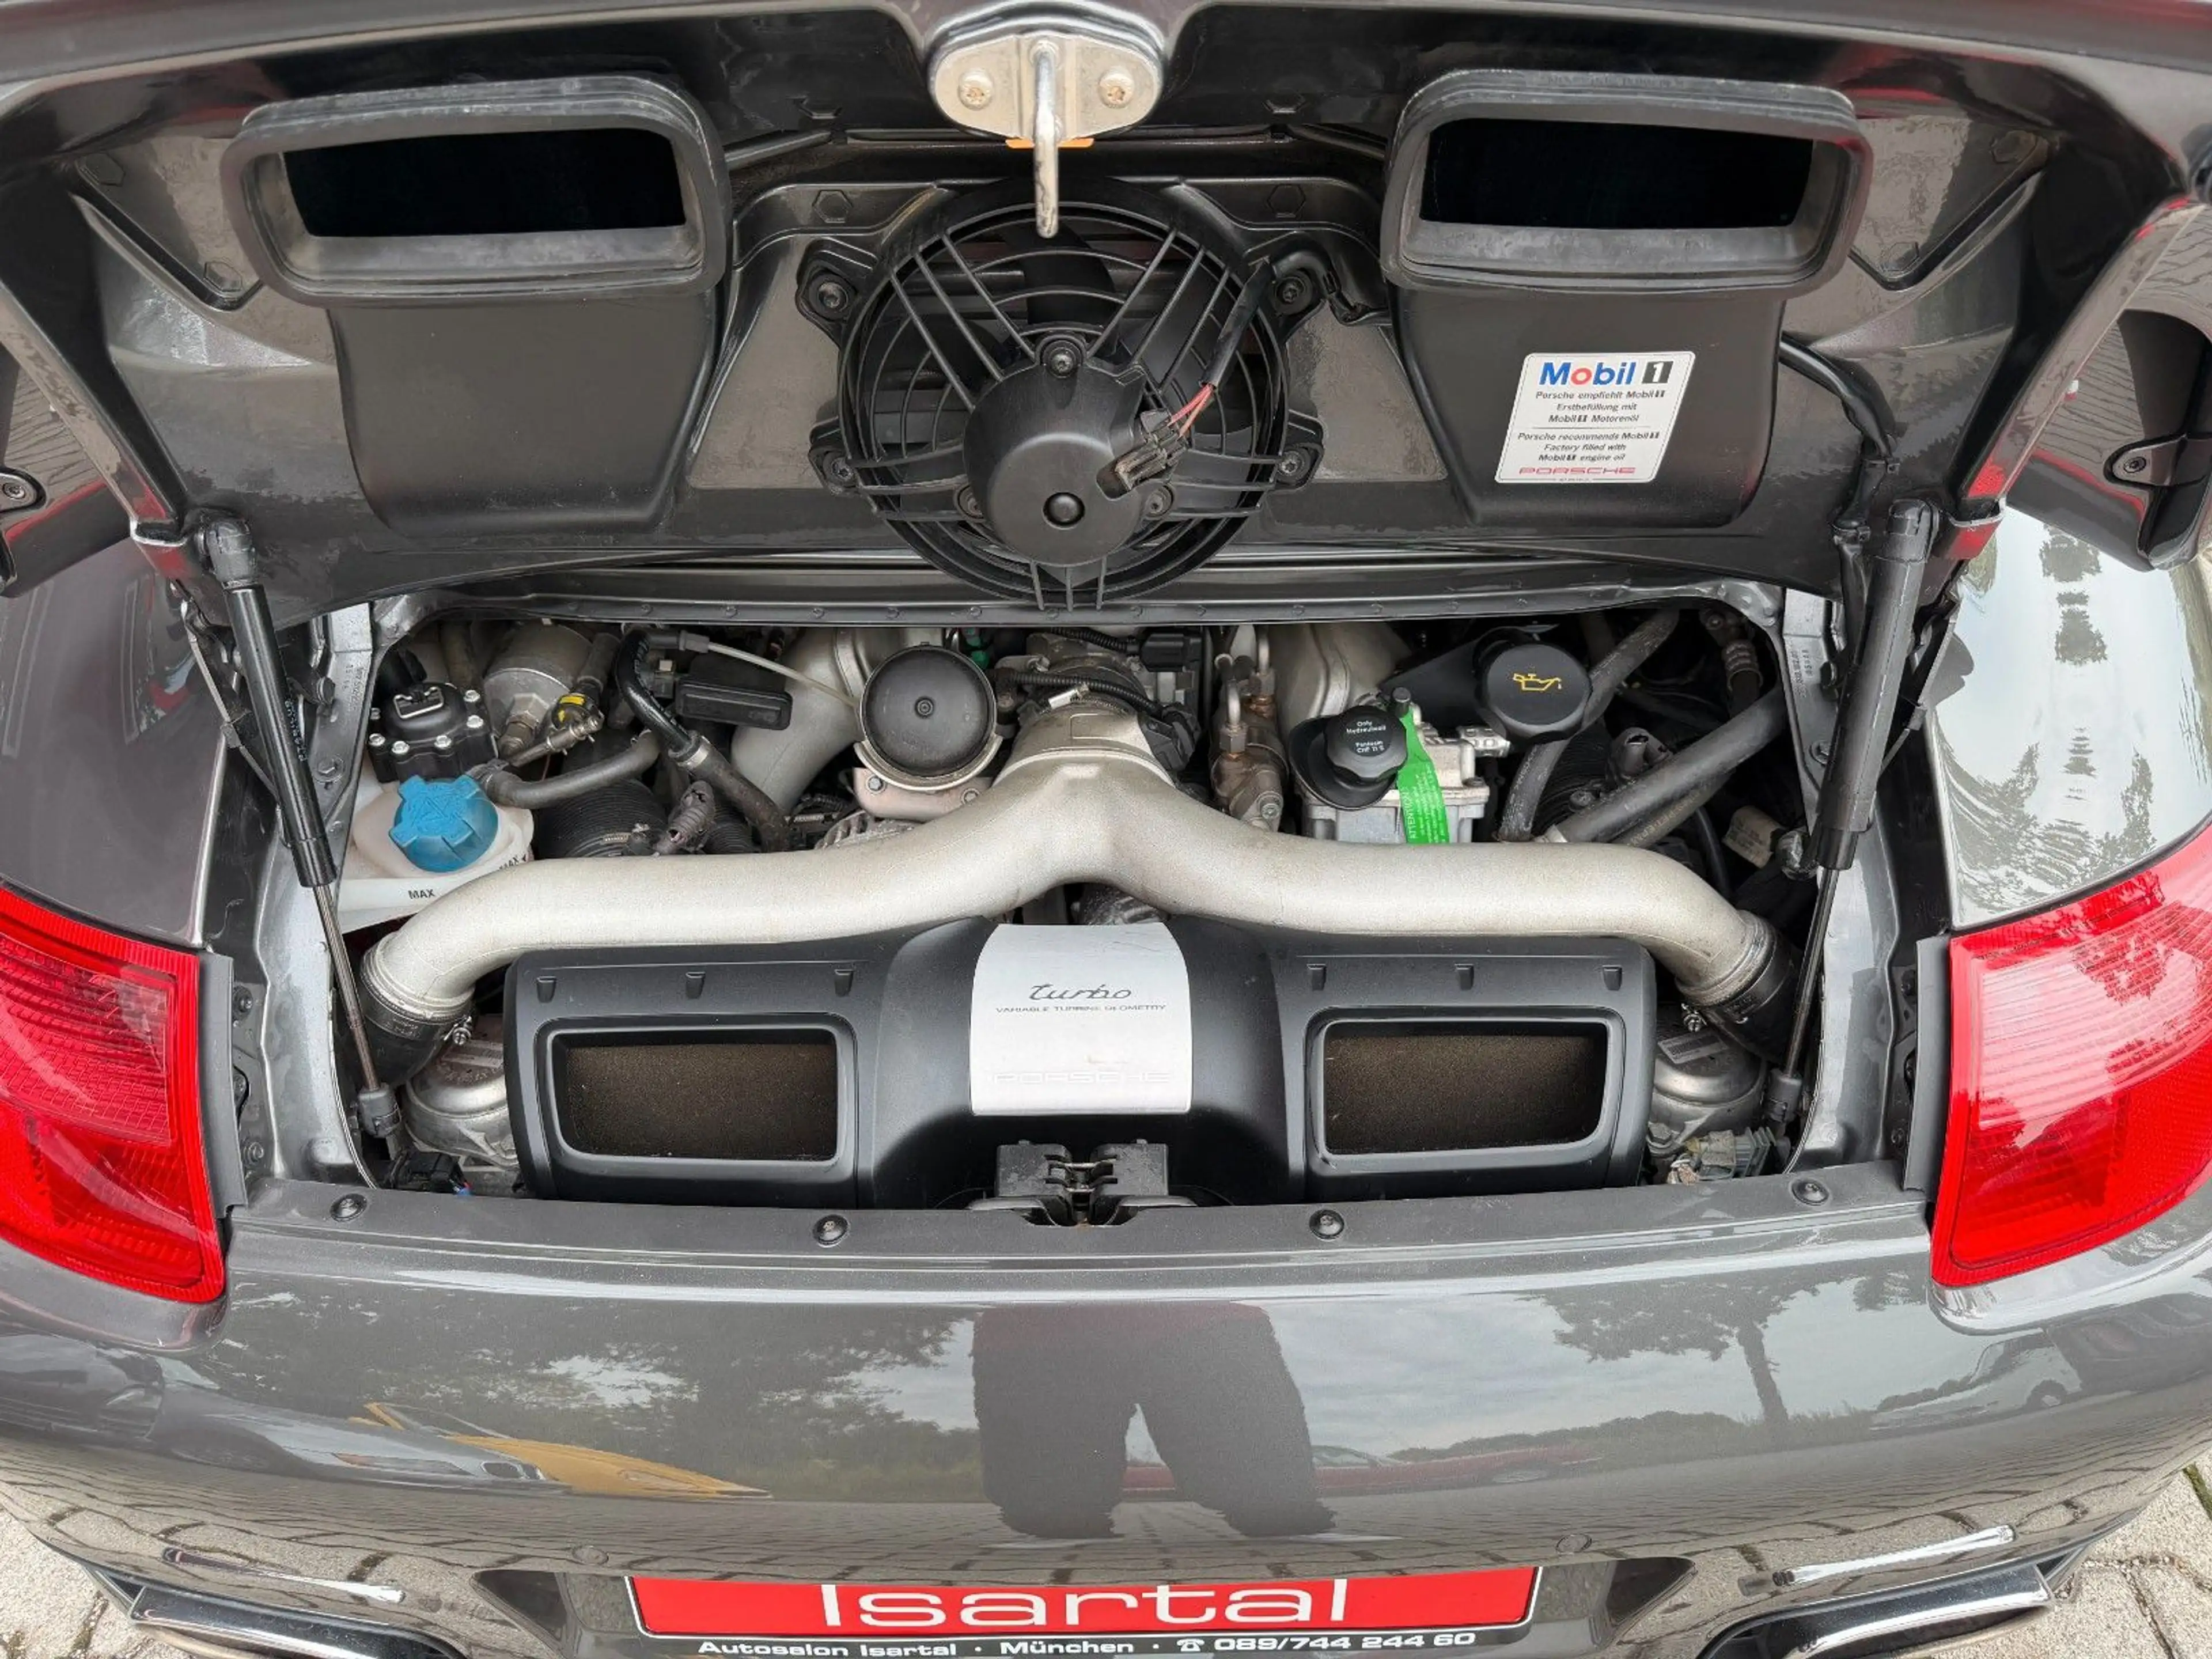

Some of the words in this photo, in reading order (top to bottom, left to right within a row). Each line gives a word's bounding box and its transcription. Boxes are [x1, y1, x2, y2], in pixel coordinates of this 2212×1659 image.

[1539, 362, 1637, 385] Mobil
[1578, 391, 1622, 400] empfiehlt
[1556, 403, 1618, 412] Erstbefüllung
[1591, 414, 1639, 422] Motorenöl
[1544, 444, 1580, 452] Factory
[408, 889, 435, 900] MAX
[1029, 984, 1132, 1001] turbo
[821, 1578, 1348, 1627] Isartal
[698, 1641, 849, 1657] Autosalon
[861, 1643, 956, 1657] Isartal
[1000, 1640, 1134, 1655] München
[1214, 1636, 1352, 1651] 089/744
[1361, 1635, 1426, 1649] 244
[1433, 1633, 1476, 1647] 60
